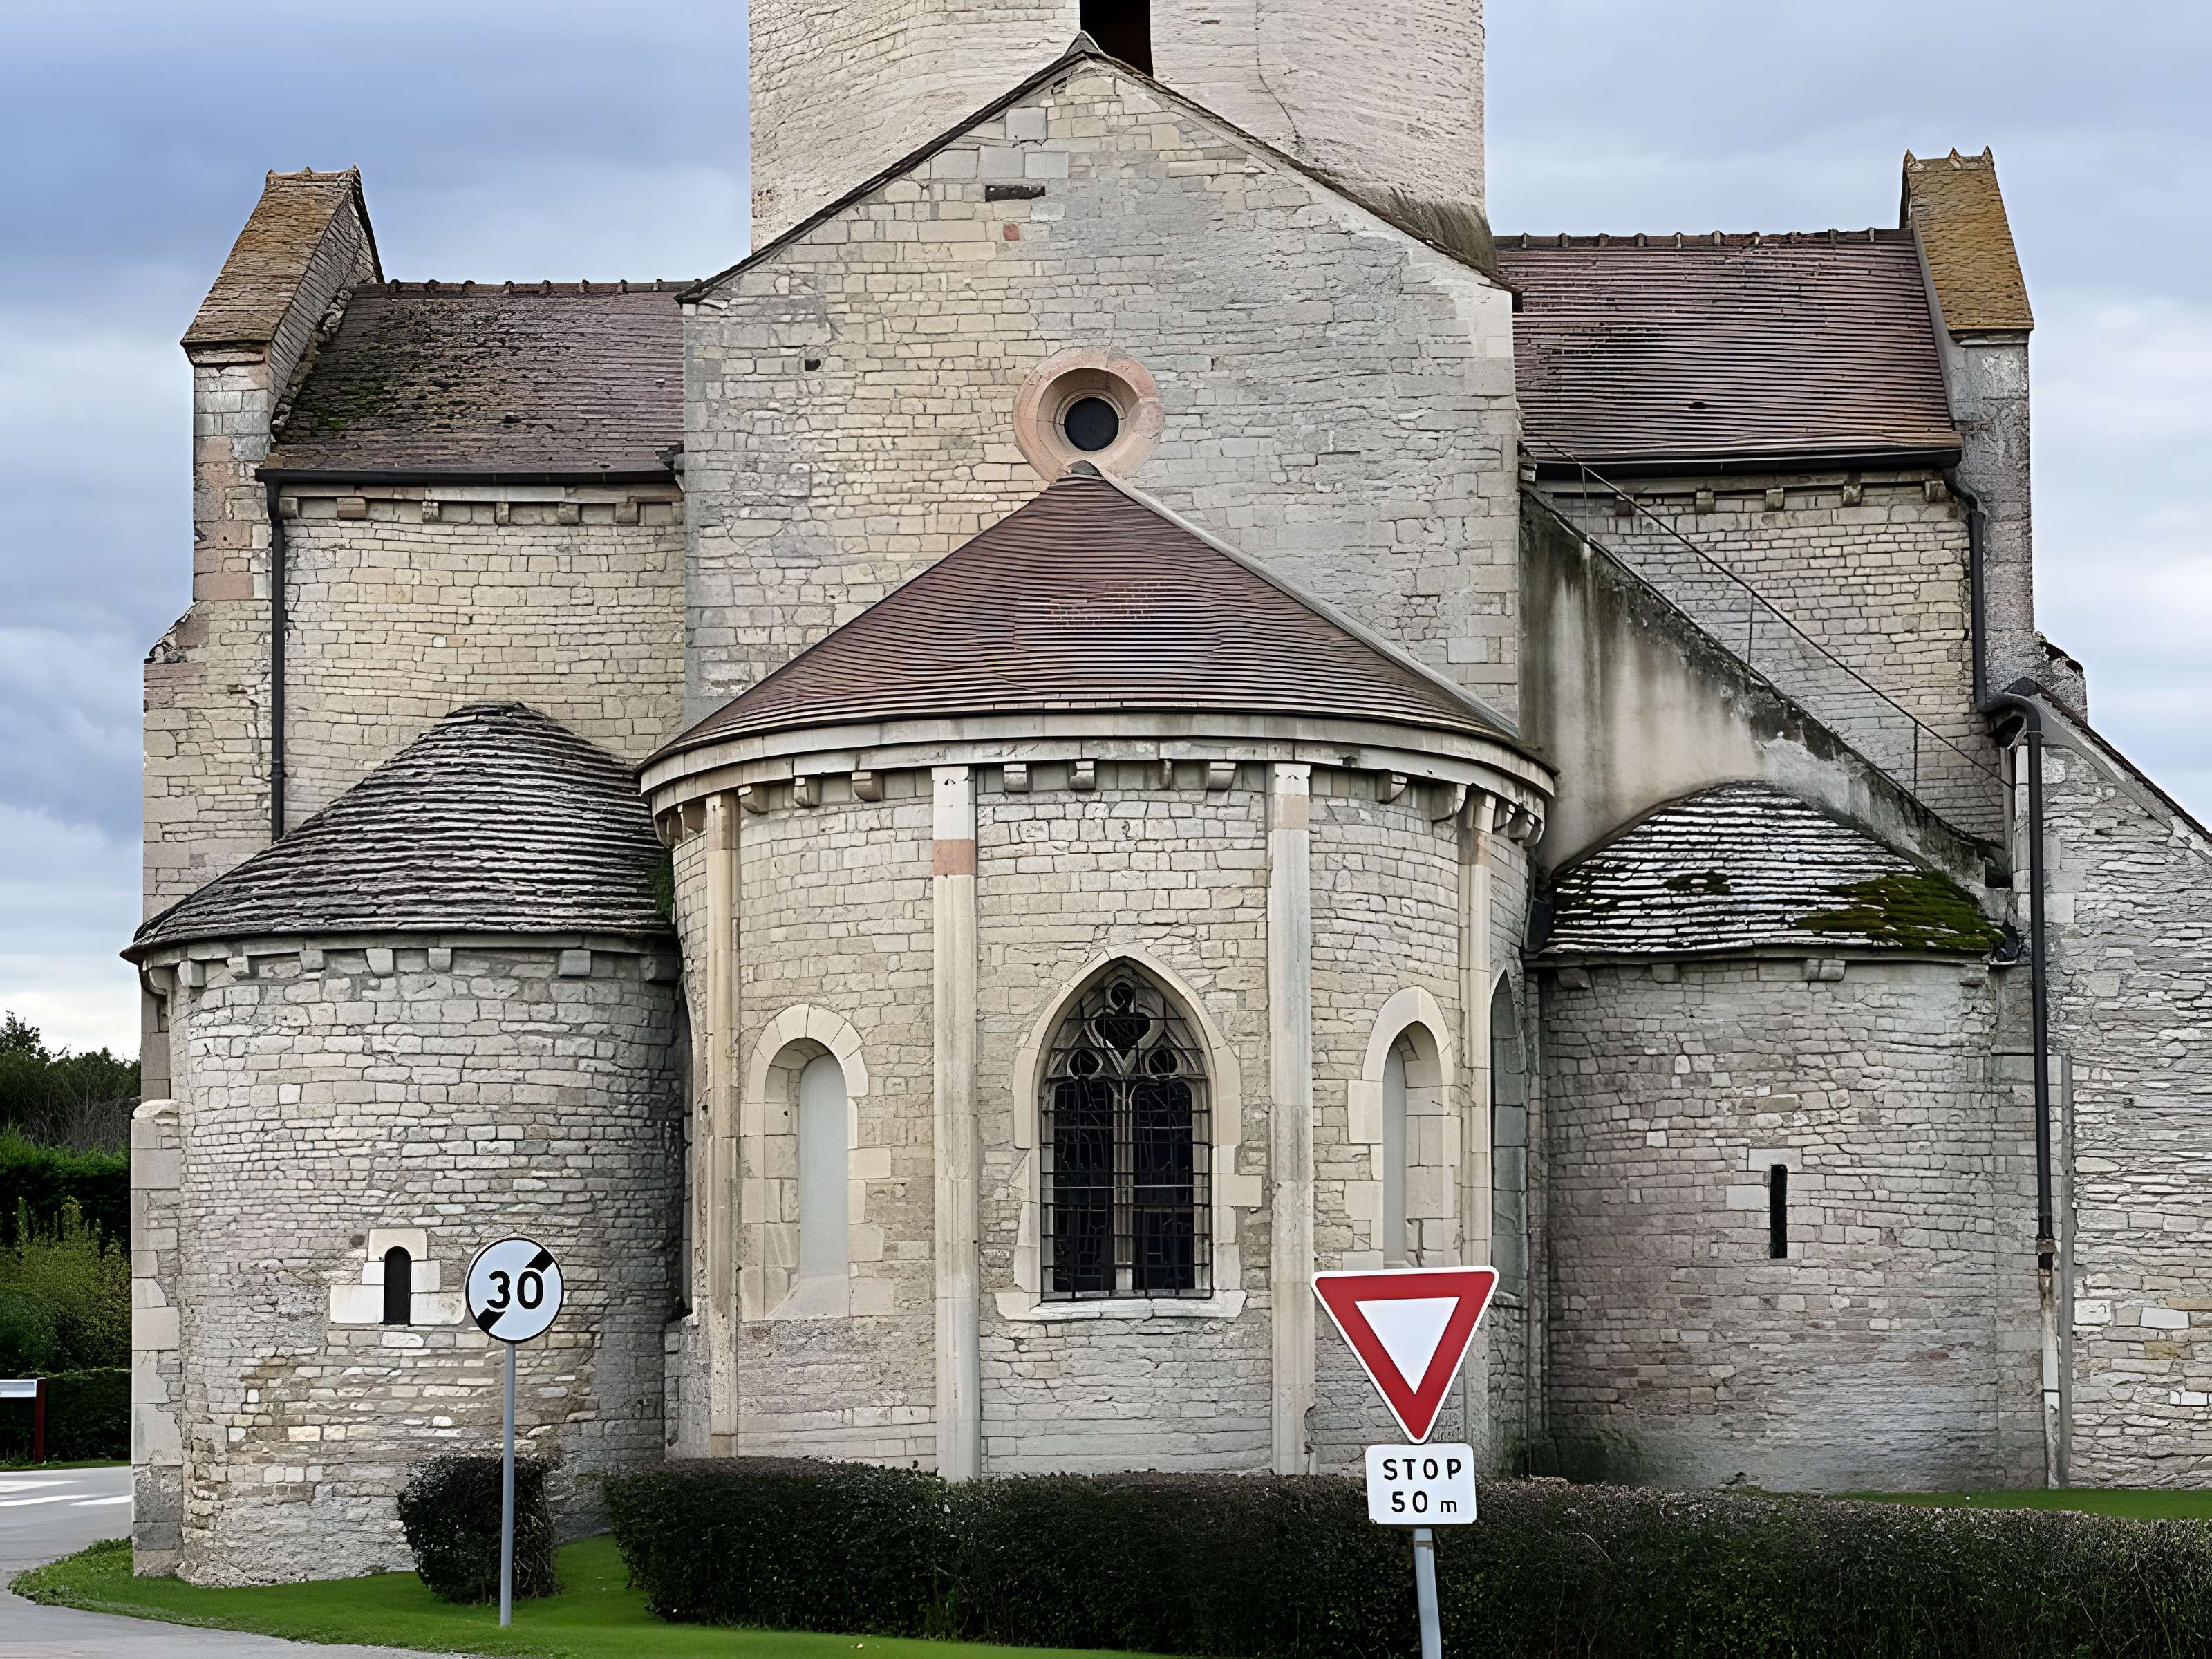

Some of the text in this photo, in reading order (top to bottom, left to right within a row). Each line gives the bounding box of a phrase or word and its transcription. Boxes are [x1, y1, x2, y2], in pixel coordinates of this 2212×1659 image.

[487, 1270, 543, 1309] 30
[1382, 1458, 1461, 1481] STOP
[1391, 1490, 1457, 1513] 50 m
